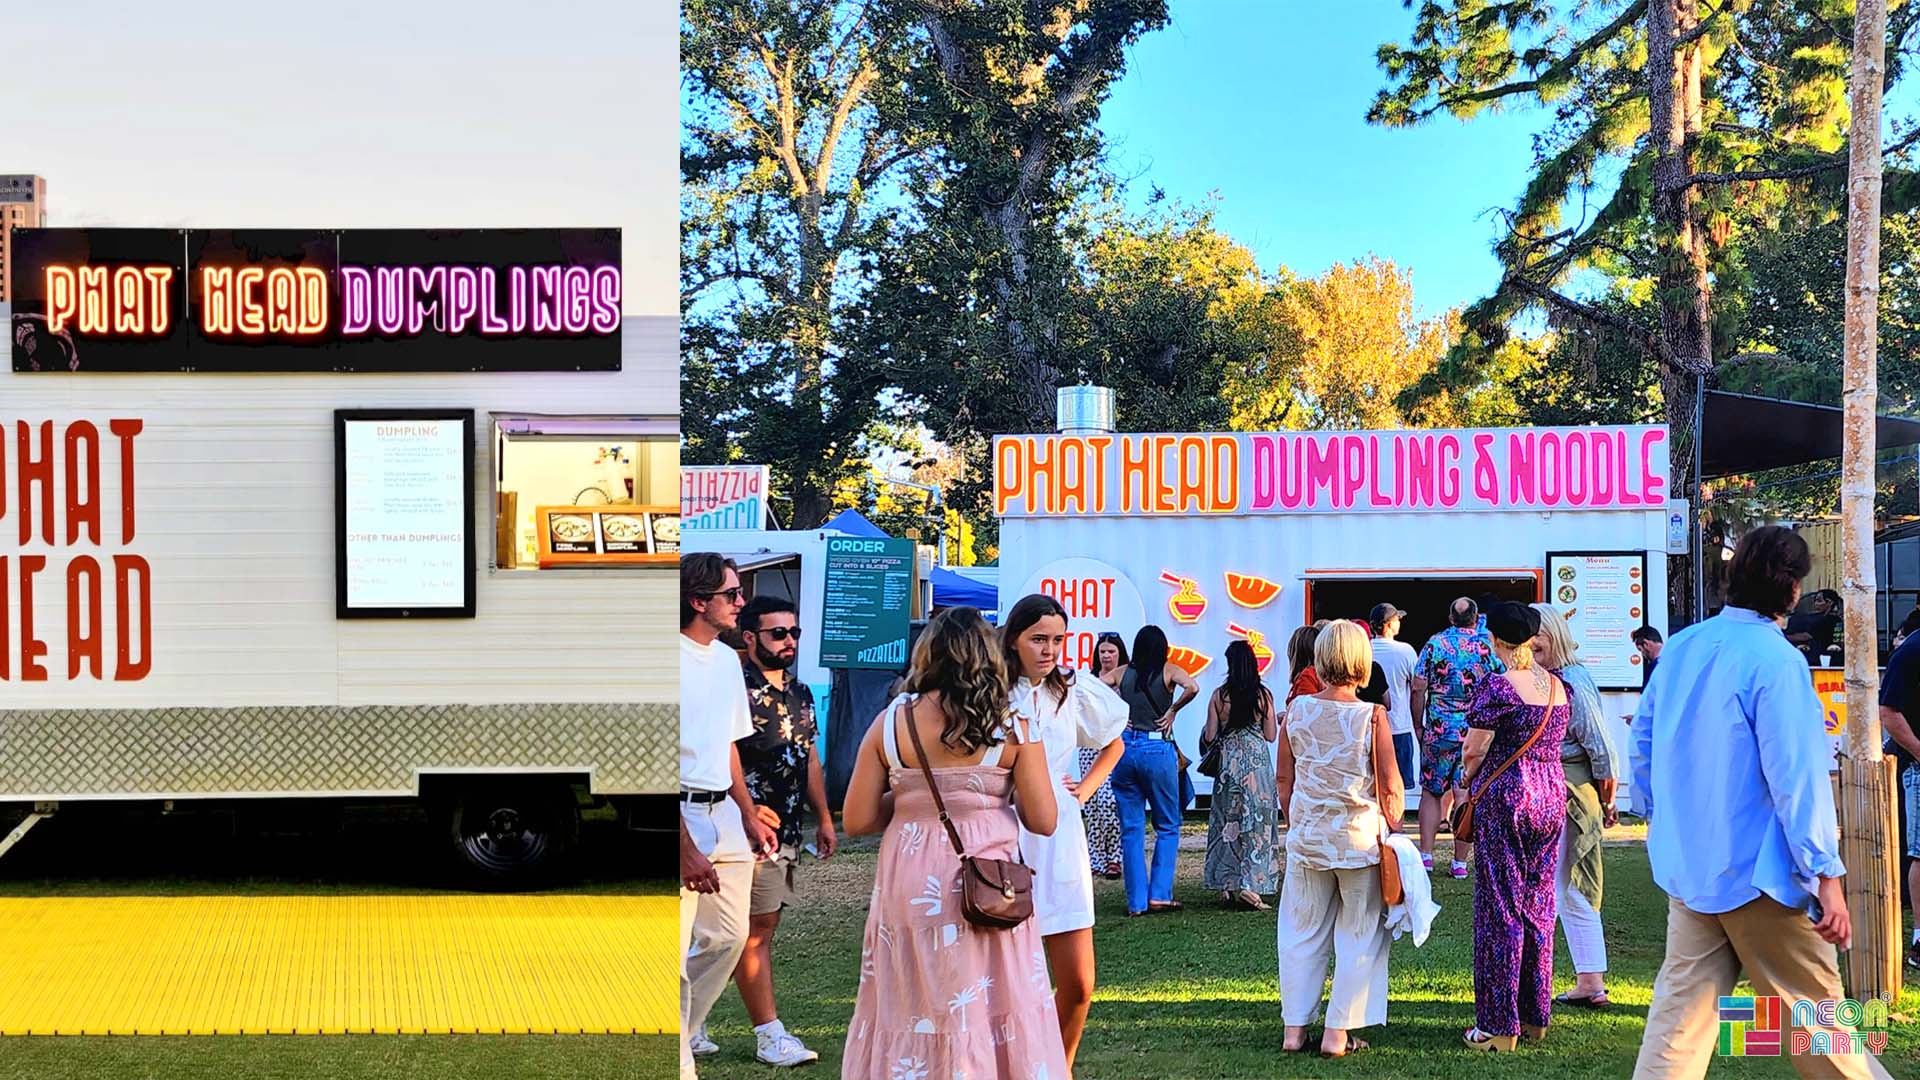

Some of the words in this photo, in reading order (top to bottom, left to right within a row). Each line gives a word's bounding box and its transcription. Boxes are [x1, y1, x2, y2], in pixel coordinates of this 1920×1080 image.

[47, 266, 173, 333] PHAT
[204, 267, 327, 334] HEAD
[341, 265, 620, 333] DUMPLINGS
[376, 426, 438, 436] DUMPLING
[0, 419, 143, 546] HAT
[996, 436, 1113, 513] PHAT
[1121, 436, 1239, 513] HEAD
[1250, 433, 1461, 509] DUMPLING
[1473, 432, 1499, 507] &
[1508, 429, 1666, 507] NOODLE
[349, 534, 378, 542] OTHER
[381, 534, 406, 542] THAN
[409, 534, 461, 542] DUMPLINGS
[831, 540, 885, 553] ORDER
[0, 555, 152, 681] EAD
[857, 639, 906, 664] PIZZATECA
